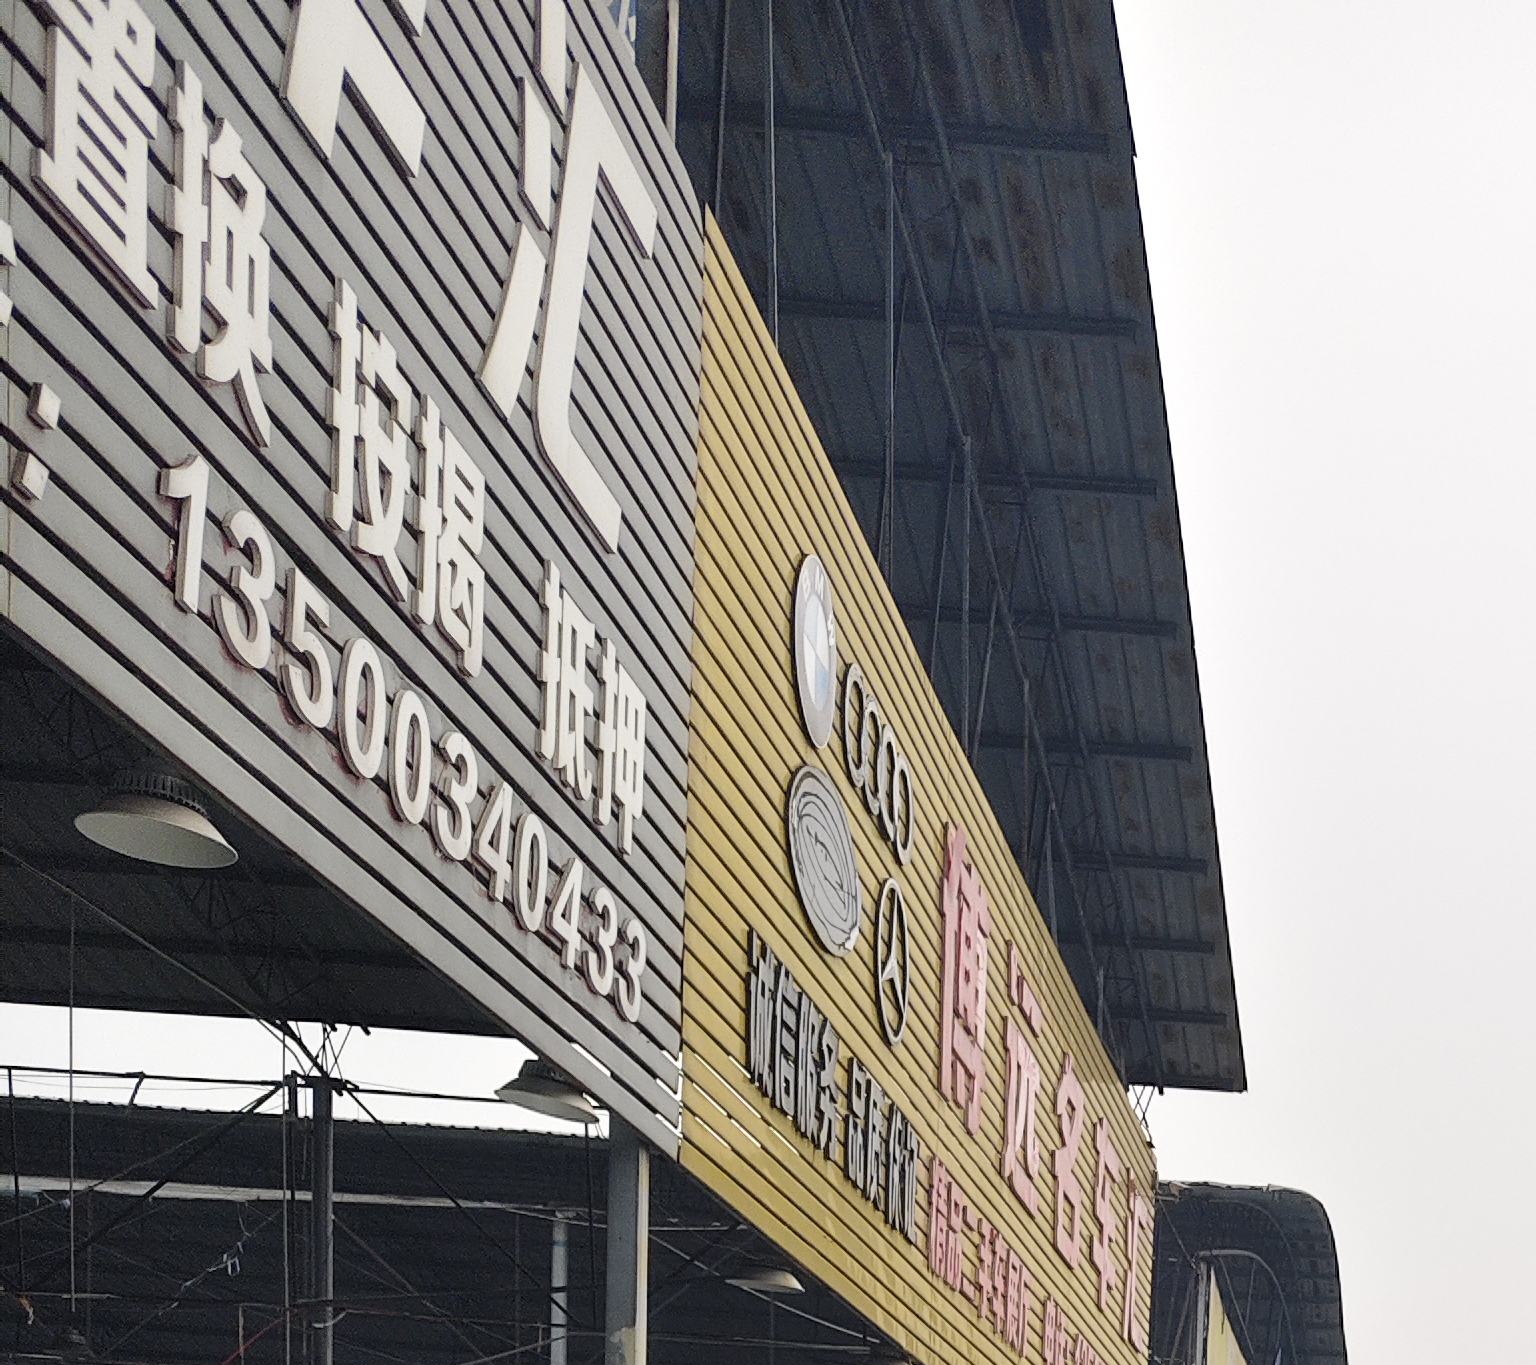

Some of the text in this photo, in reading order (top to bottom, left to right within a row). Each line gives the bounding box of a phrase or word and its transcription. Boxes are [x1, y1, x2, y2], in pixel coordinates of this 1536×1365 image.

[30, 0, 647, 856] 置换 按揭 抵押
[155, 453, 648, 1025] 13500340433
[747, 927, 920, 1245] 诚信服务 品质保证
[928, 1156, 1032, 1358] 精品二手车展厅
[938, 822, 1150, 1355] 博远名车汇
